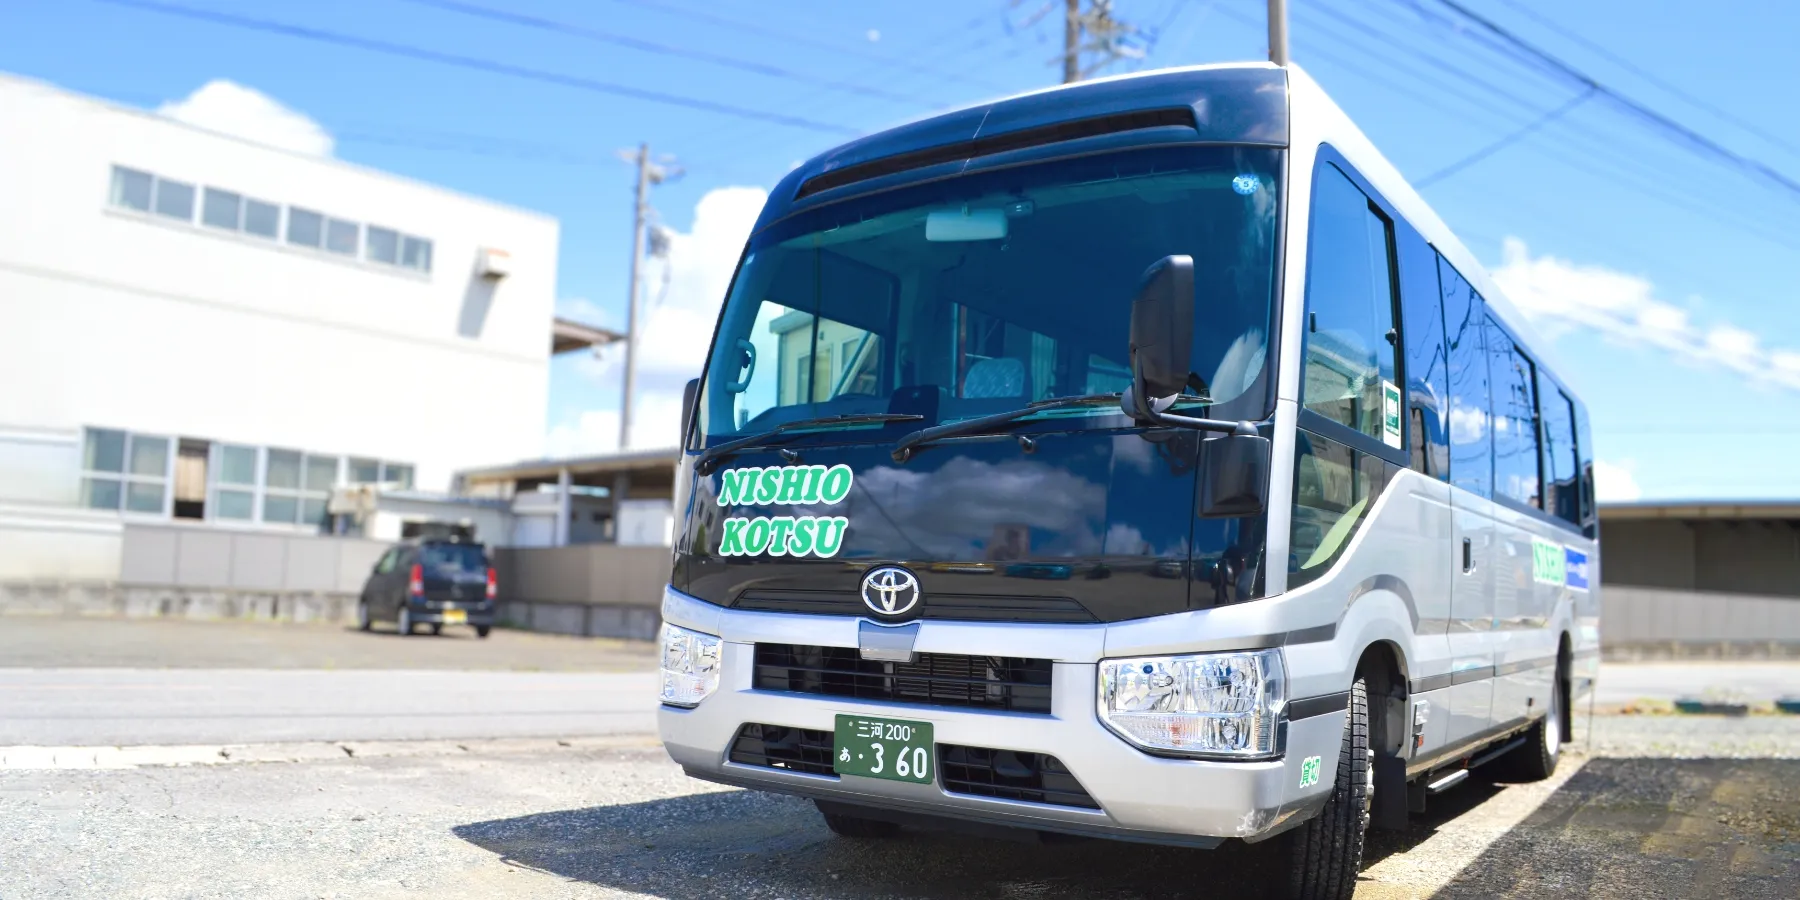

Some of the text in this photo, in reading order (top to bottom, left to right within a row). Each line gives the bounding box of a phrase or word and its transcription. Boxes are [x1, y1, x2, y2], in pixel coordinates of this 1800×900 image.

[718, 465, 853, 504] NISHIO
[720, 517, 847, 557] KOTSU
[839, 746, 851, 763] あ
